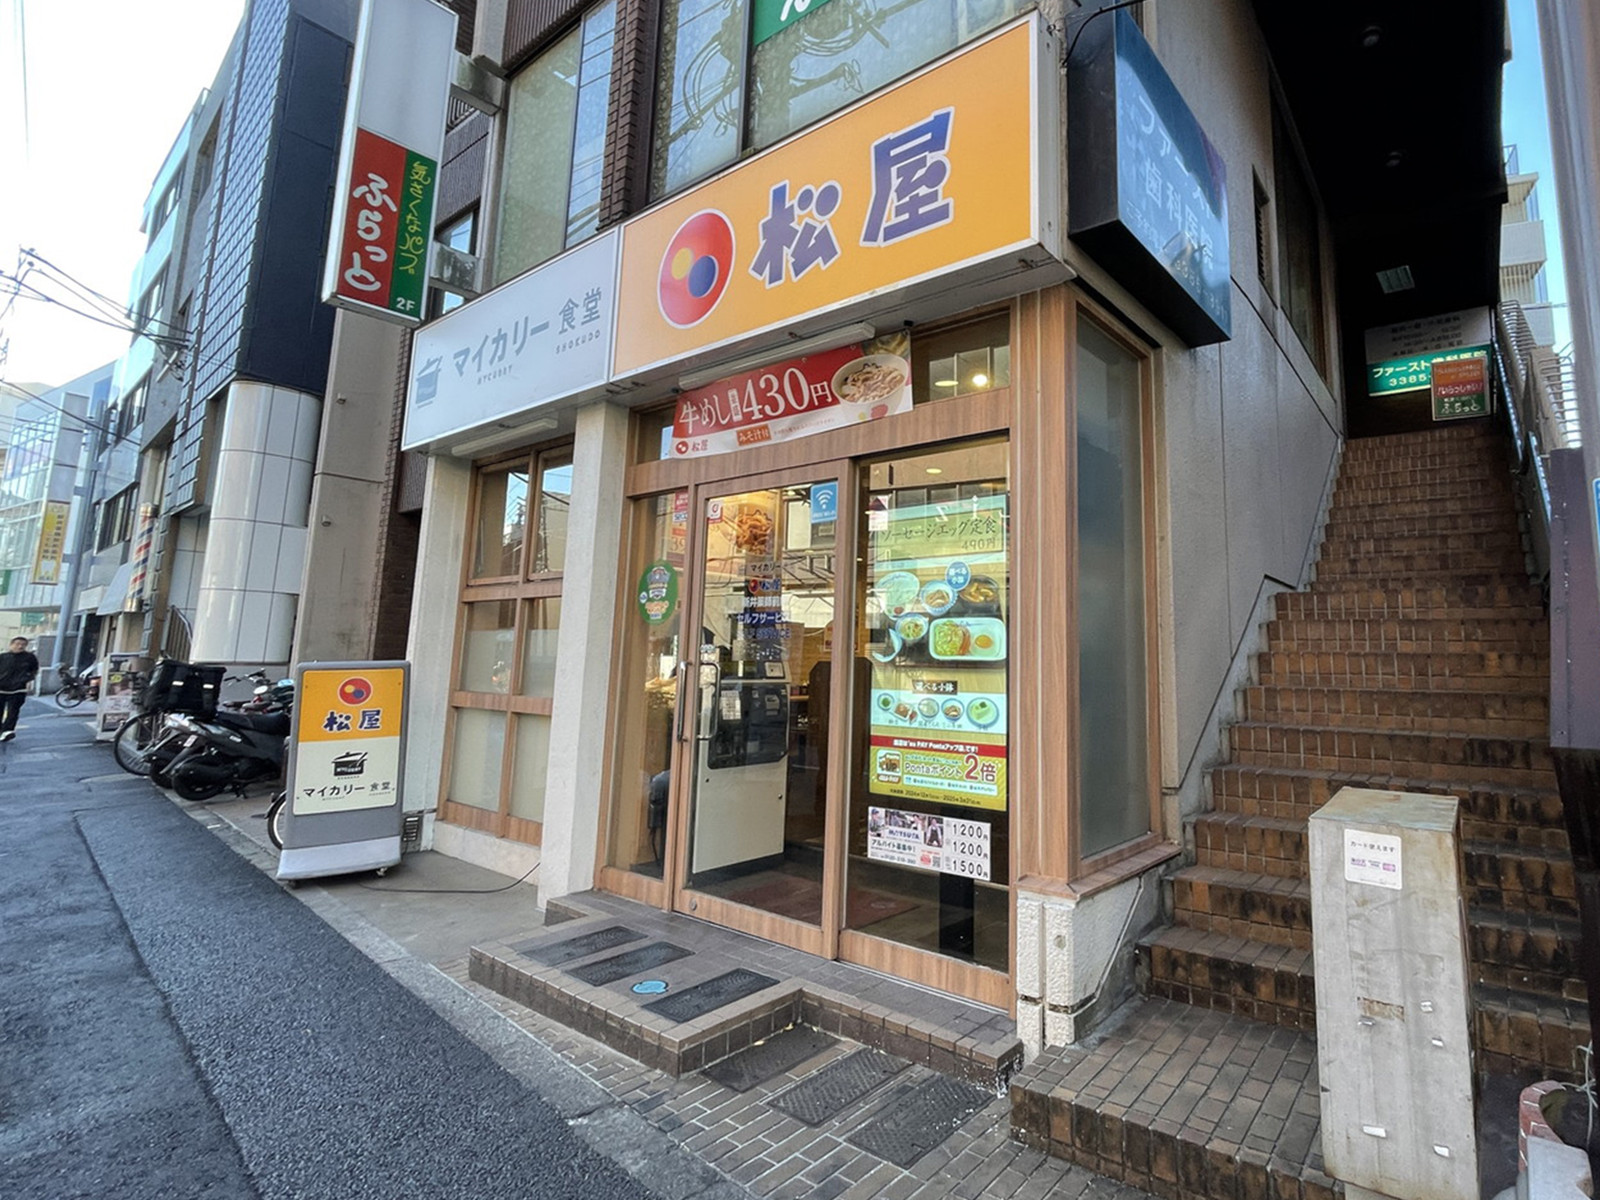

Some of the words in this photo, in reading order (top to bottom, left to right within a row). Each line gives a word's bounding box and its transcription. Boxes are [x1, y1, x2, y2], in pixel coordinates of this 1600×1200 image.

[748, 106, 955, 289] 松屋
[399, 161, 431, 275] 気さくなパブ
[344, 173, 397, 291] ふらっと
[396, 297, 416, 311] 2F
[453, 316, 550, 377] マイカリー
[558, 287, 602, 335] 食堂
[556, 329, 601, 354] SHOKUDO
[679, 394, 731, 434] 牛めし
[743, 367, 833, 421] 430円
[1441, 399, 1481, 414] ふらっと
[881, 515, 997, 541] ソーセージエッグ定食
[961, 537, 996, 551] 490円
[751, 563, 781, 572] マイカリー
[322, 709, 382, 732] 松屋
[905, 762, 962, 777] Pontaポイント
[303, 783, 365, 798] マイカリー
